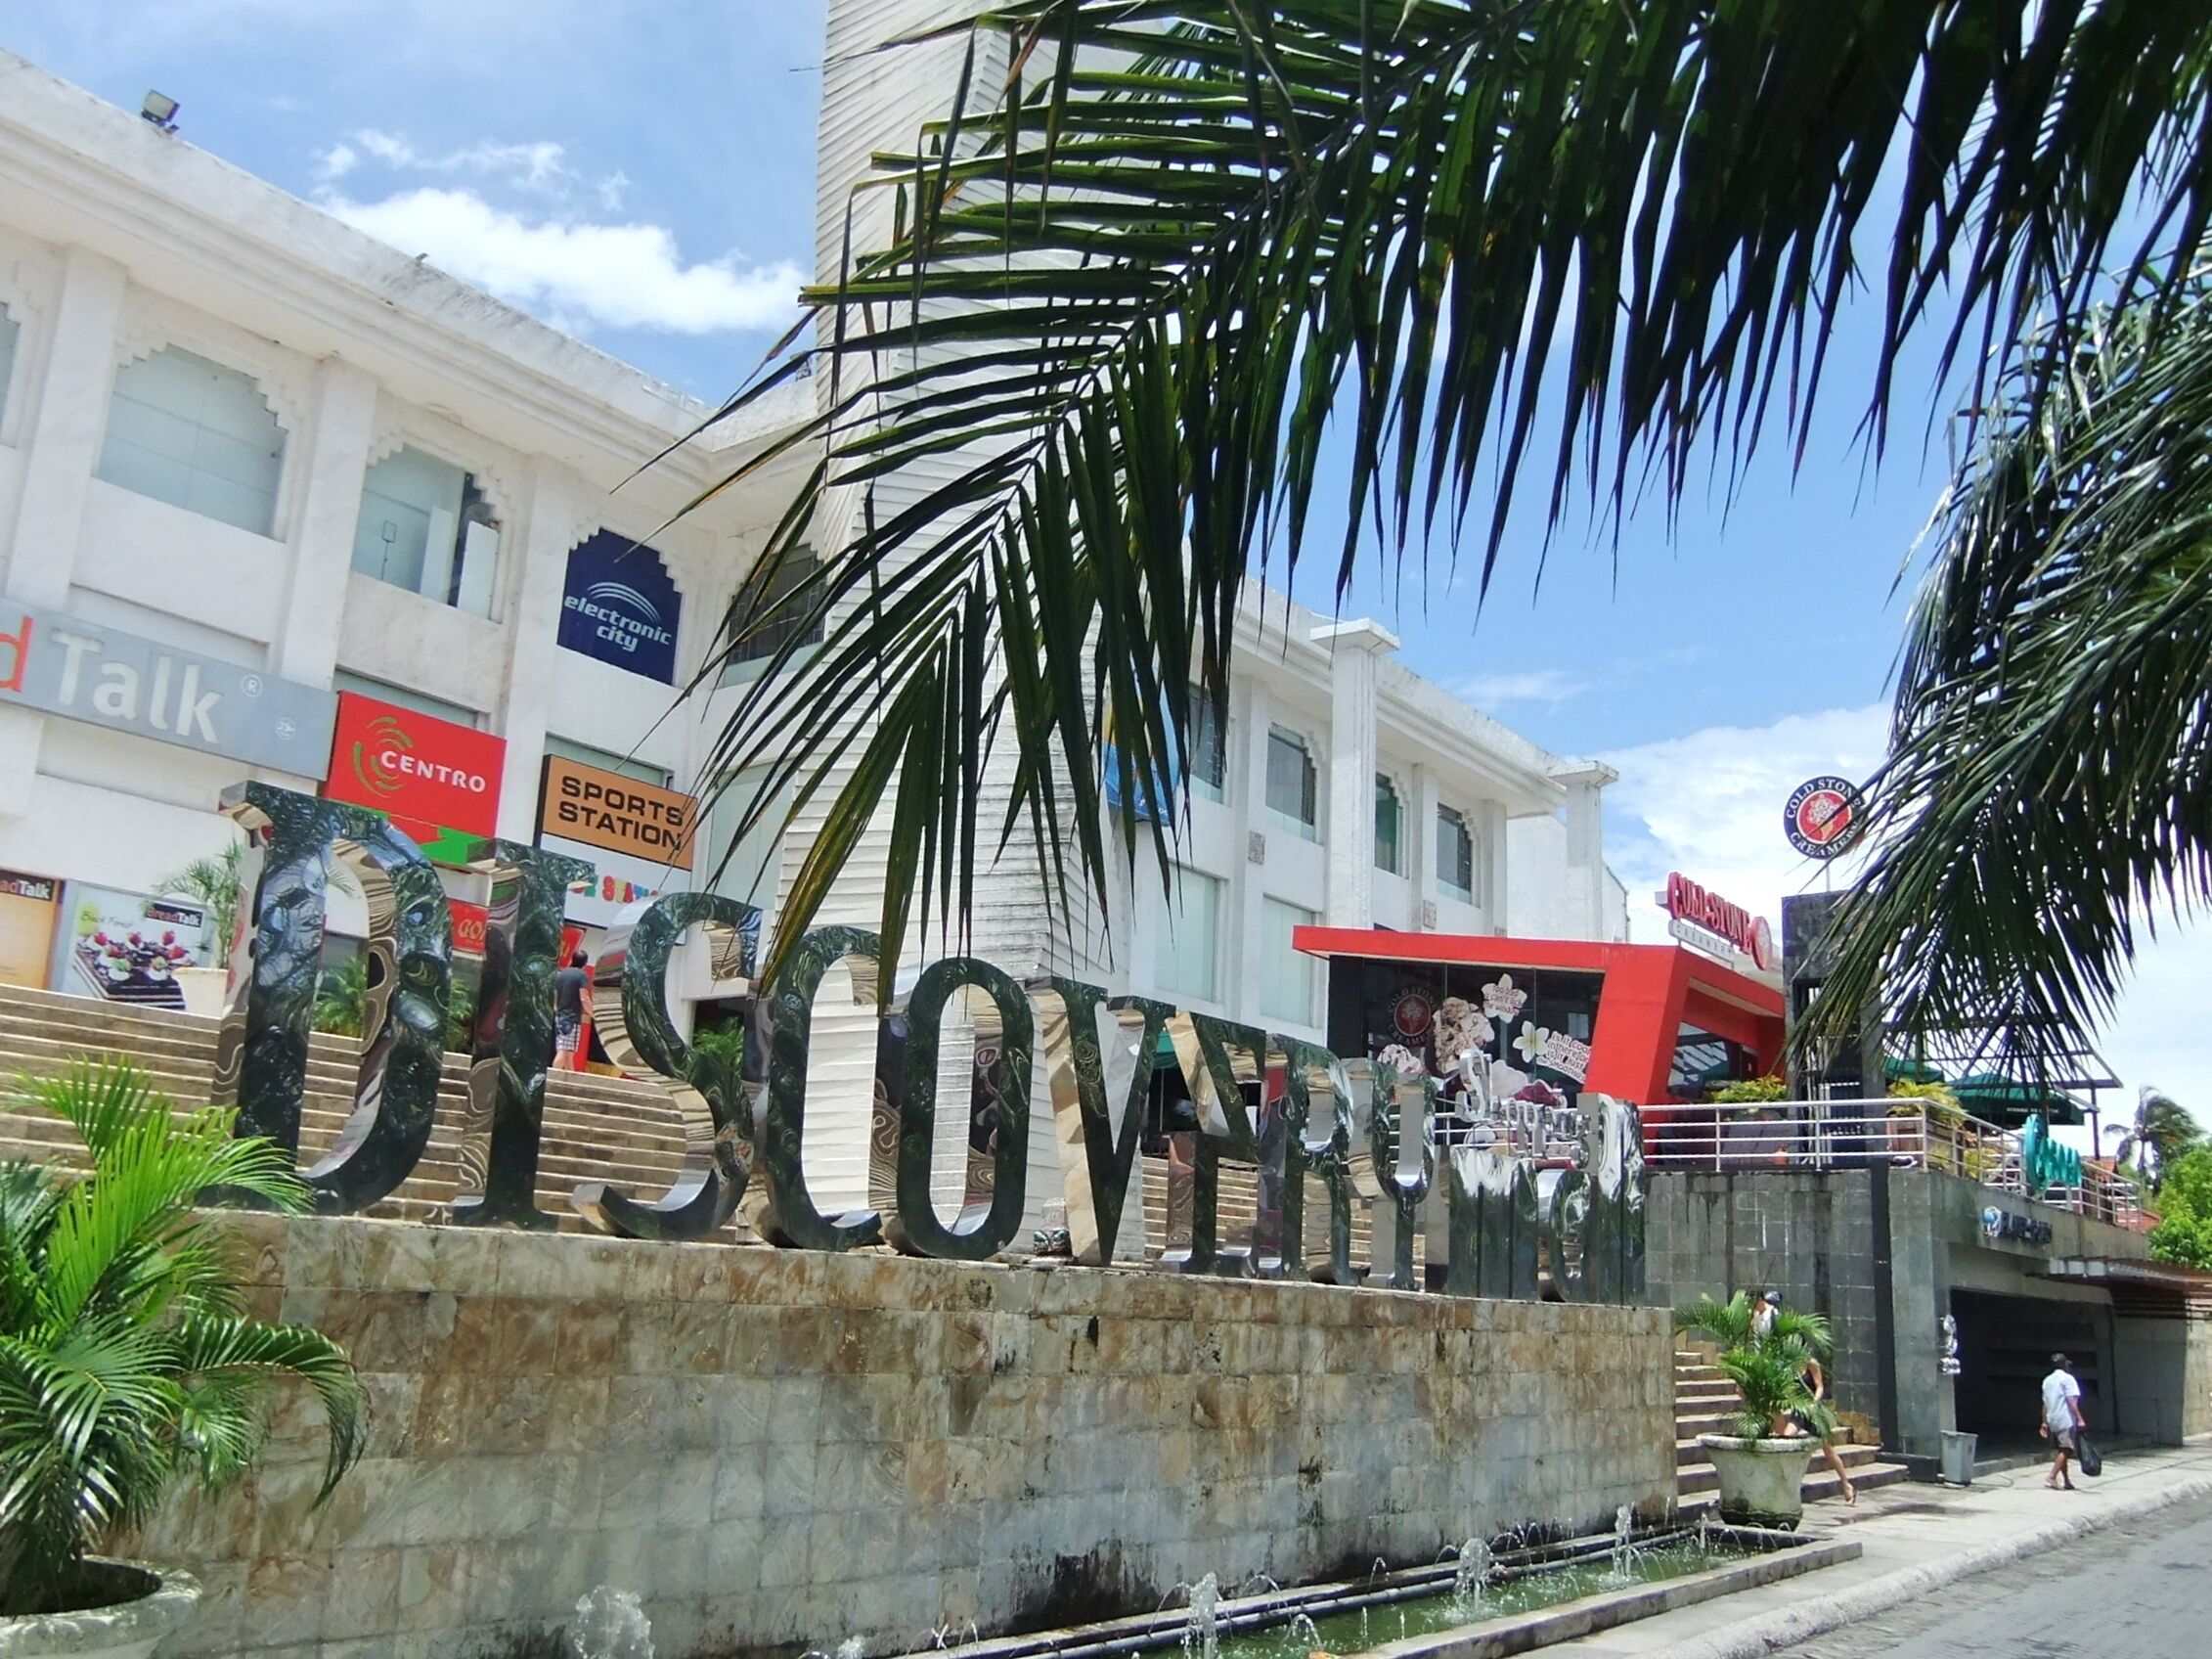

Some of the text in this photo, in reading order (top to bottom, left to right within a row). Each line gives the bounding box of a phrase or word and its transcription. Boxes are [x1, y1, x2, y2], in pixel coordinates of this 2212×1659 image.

[563, 595, 673, 646] electronic
[596, 625, 639, 652] city
[380, 750, 486, 793] CENTRO
[561, 775, 684, 828] SPORTS
[1786, 783, 1815, 819] COLD
[558, 800, 684, 851] STATION
